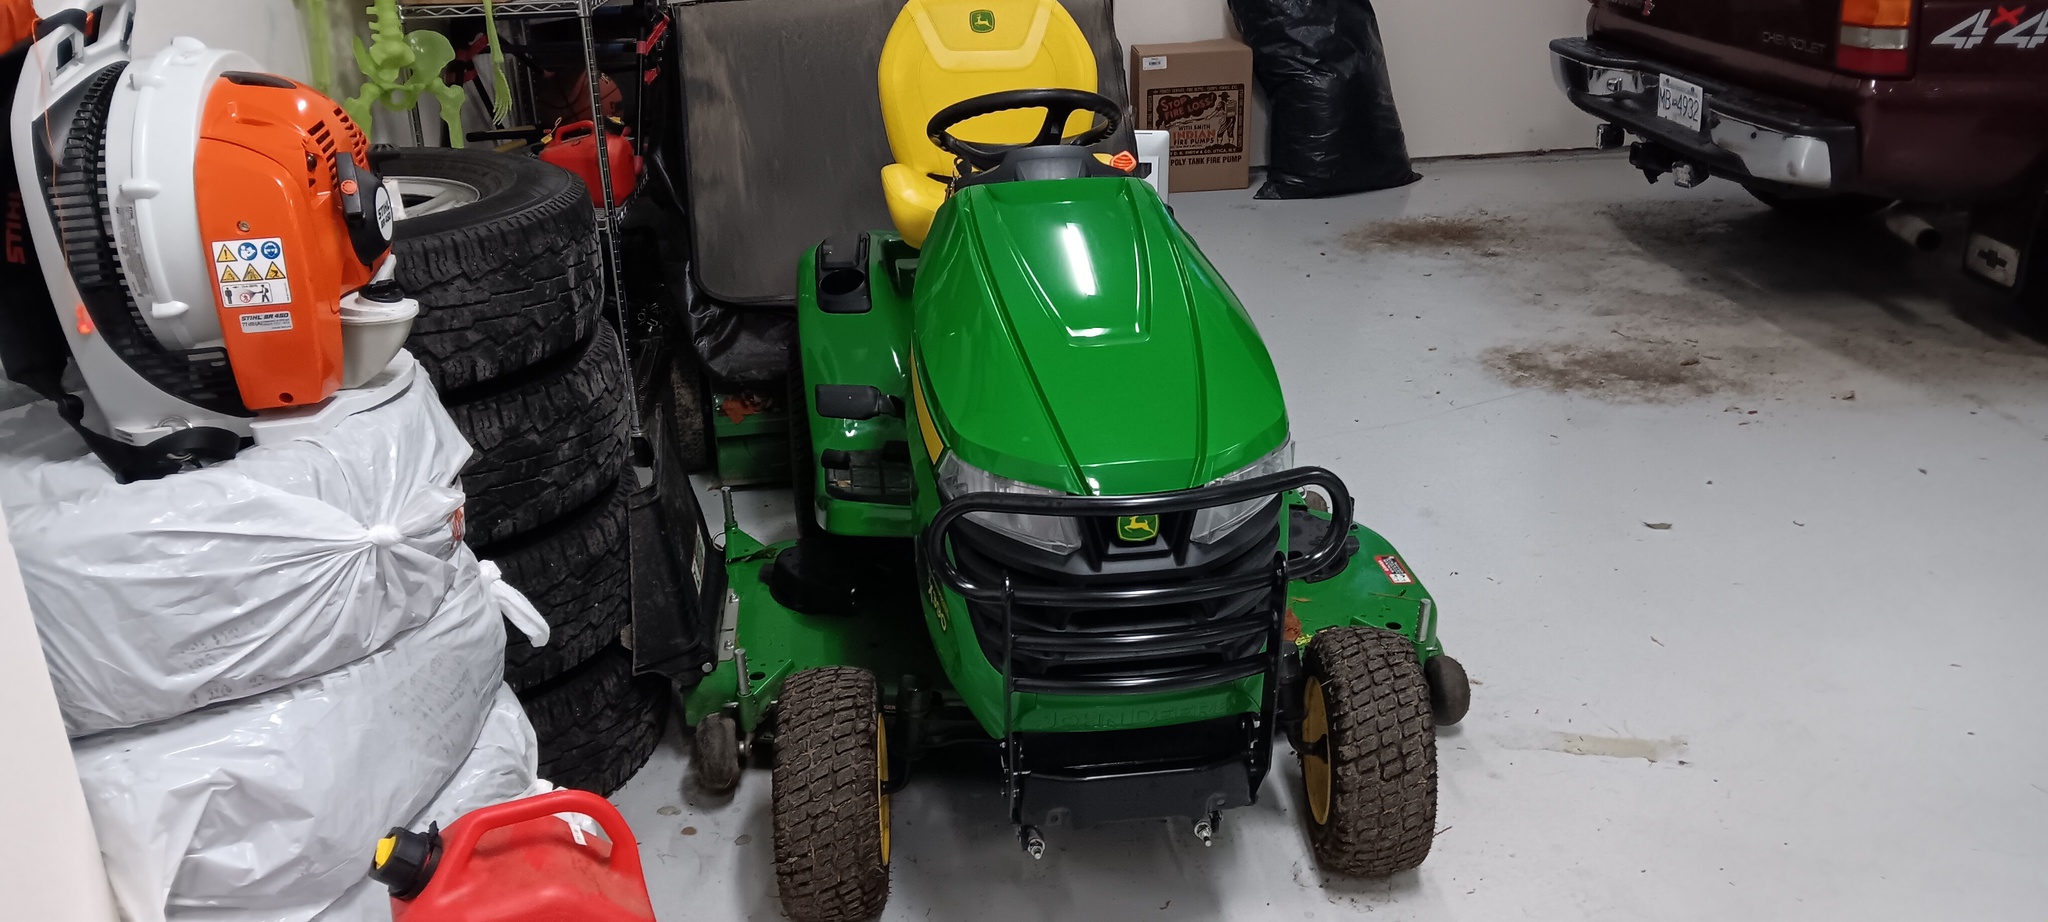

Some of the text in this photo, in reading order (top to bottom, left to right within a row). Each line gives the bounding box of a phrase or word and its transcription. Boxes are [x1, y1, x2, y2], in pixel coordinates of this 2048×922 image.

[1161, 96, 1187, 112] STOP
[1164, 107, 1185, 120] FIRE
[1187, 94, 1215, 113] LOSS!
[1677, 94, 1699, 122] 4932
[1172, 129, 1216, 140] INDIAN
[1173, 137, 1214, 146] FIRE PUMPS
[1222, 155, 1242, 163] PUMP
[1045, 702, 1229, 729] JOHN DEERE
